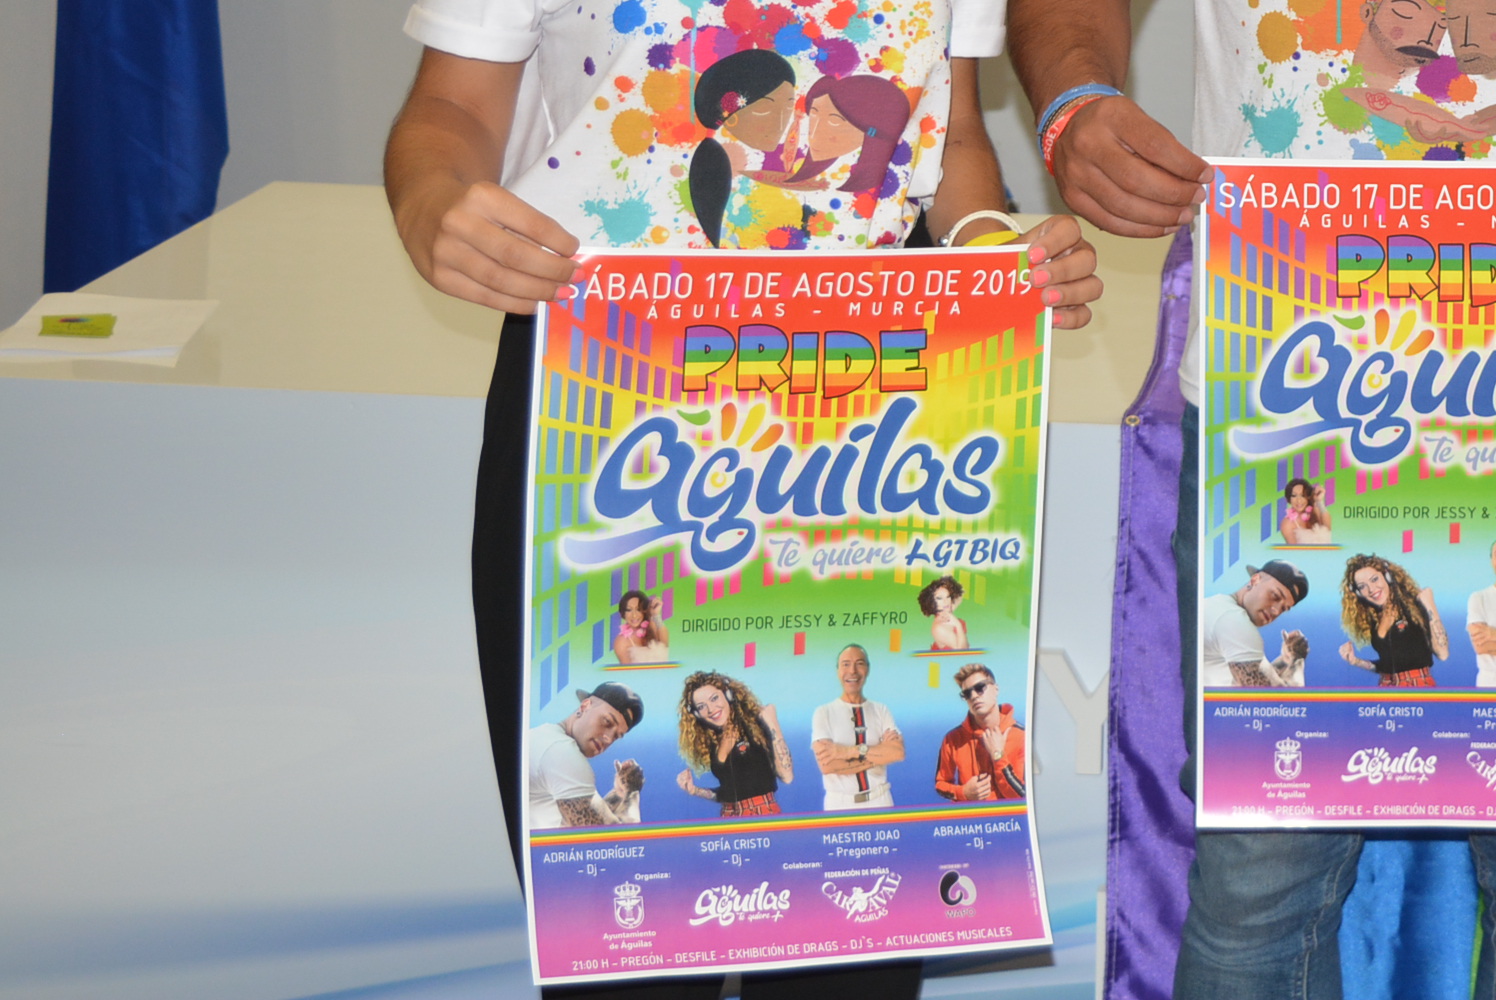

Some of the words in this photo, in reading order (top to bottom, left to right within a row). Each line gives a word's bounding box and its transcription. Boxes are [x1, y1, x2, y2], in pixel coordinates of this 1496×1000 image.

[1219, 174, 1340, 208] SÁBADO
[1352, 184, 1378, 208] 17
[1390, 184, 1424, 209] DE
[1300, 210, 1430, 228] ÁGUILAS
[704, 273, 734, 297] 17
[744, 273, 783, 298] DE
[792, 271, 916, 298] AGOSTO
[924, 269, 961, 296] DE
[971, 268, 1032, 295] 2019
[645, 297, 786, 318] ÁGUILAS
[848, 300, 961, 317] MURCIA
[682, 324, 928, 399] PRIDE
[1424, 436, 1454, 463] Te
[1343, 506, 1399, 519] DIRIGIDO
[1403, 506, 1430, 519] POR
[1435, 506, 1476, 519] JESSY
[1482, 506, 1488, 519] &
[769, 538, 801, 568] Te
[811, 539, 897, 575] quiere
[904, 535, 1021, 569] LGTBIQ
[681, 616, 741, 633] DIRIGIDO
[745, 615, 774, 630] POR
[779, 613, 822, 629] JESSY
[827, 613, 835, 627] &
[842, 611, 907, 627] ZAFFYRO
[1214, 704, 1250, 717] ADRIÁN
[1253, 704, 1307, 717] RODRÍGUEZ
[1358, 704, 1386, 717] SOFÍA
[1389, 706, 1424, 717] CRISTO
[1253, 719, 1262, 731] Dj
[1386, 720, 1396, 732] Dj
[1275, 802, 1314, 816] PREGÓN
[1324, 806, 1362, 816] DESFILE
[1374, 802, 1426, 816] EXHIBICIÓN
[1428, 806, 1440, 816] DE
[1442, 806, 1476, 816] DRAGS
[932, 822, 983, 837] ABRAHAM
[984, 818, 1021, 834] GARCÍA
[700, 837, 732, 852] SOFÍA
[734, 836, 771, 850] CRISTO
[822, 830, 871, 845] MAESTRO
[874, 828, 901, 841] JOAO
[973, 836, 984, 849] Dj
[543, 847, 584, 864] ADRIÁN
[586, 844, 644, 860] RODRÍGUEZ
[836, 843, 890, 859] Pregonero
[731, 853, 743, 867] Dj
[782, 860, 823, 871] Colaboran:
[586, 862, 598, 877] Dj
[634, 871, 671, 881] Organiza:
[603, 930, 656, 940] Ayuntamiento
[571, 960, 601, 974] 21:00
[600, 959, 610, 971] H
[620, 952, 664, 968] PREGÓN
[675, 950, 718, 965] DESFILE
[728, 941, 787, 960] EXHIBICIÓN
[787, 943, 802, 955] DE
[803, 940, 841, 954] DRAGS
[885, 930, 958, 948] ACTUACIONES
[957, 926, 1016, 943] MUSICALES
[609, 942, 619, 950] de
[620, 940, 653, 950] Águilas
